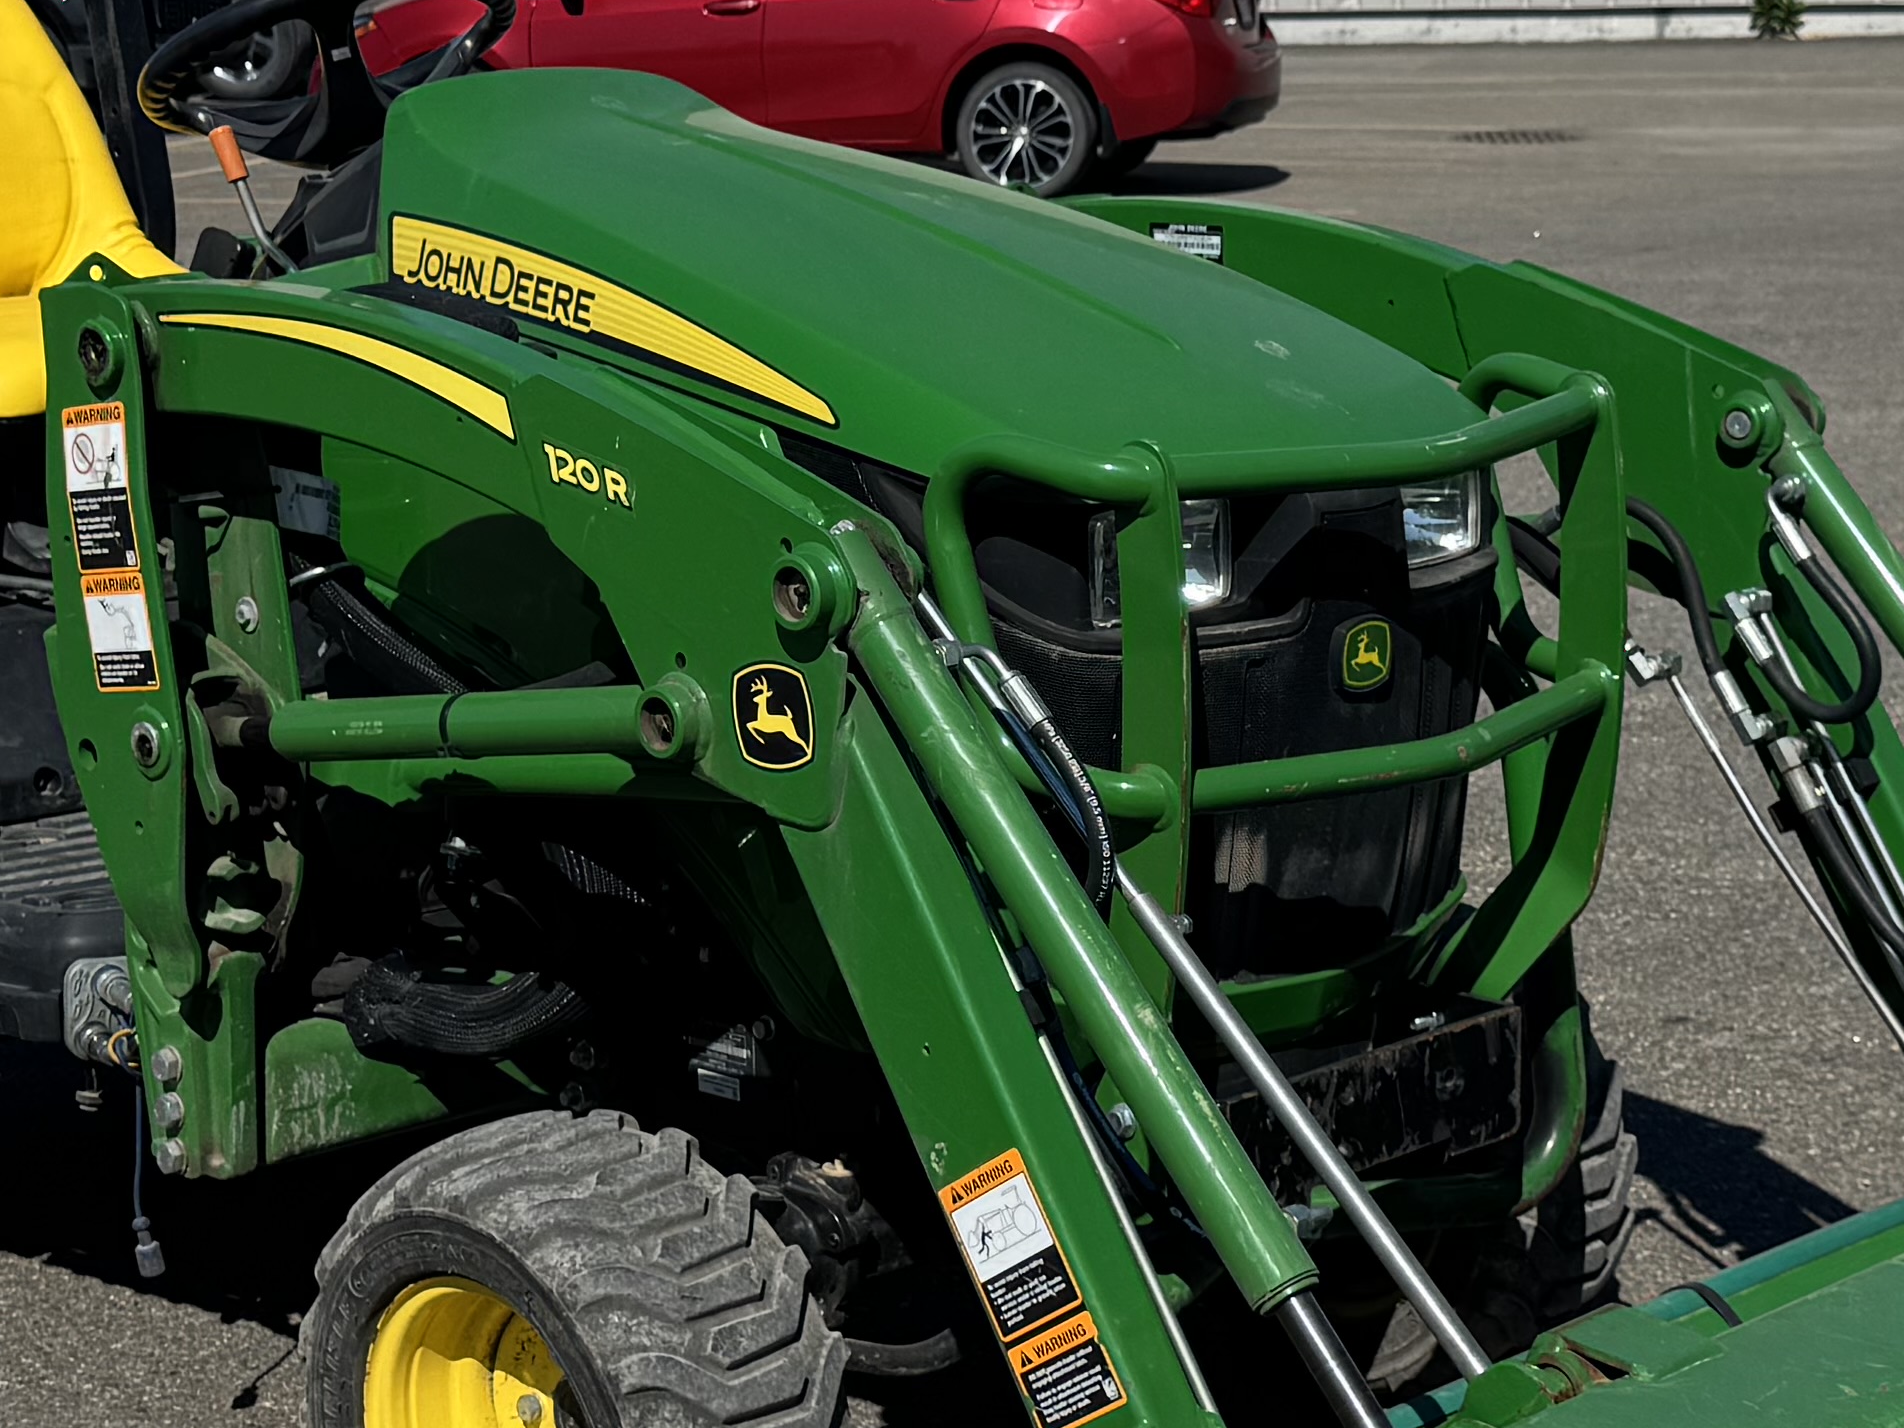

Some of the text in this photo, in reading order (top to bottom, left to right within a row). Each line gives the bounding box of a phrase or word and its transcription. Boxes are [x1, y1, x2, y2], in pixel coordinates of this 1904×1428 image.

[406, 237, 596, 328] JOHN DEERE
[73, 406, 121, 422] WARNING
[542, 441, 632, 509] 120 R
[92, 576, 141, 592] WARNING
[961, 1159, 1014, 1197] WARNING
[1031, 1323, 1087, 1359] WARNING
